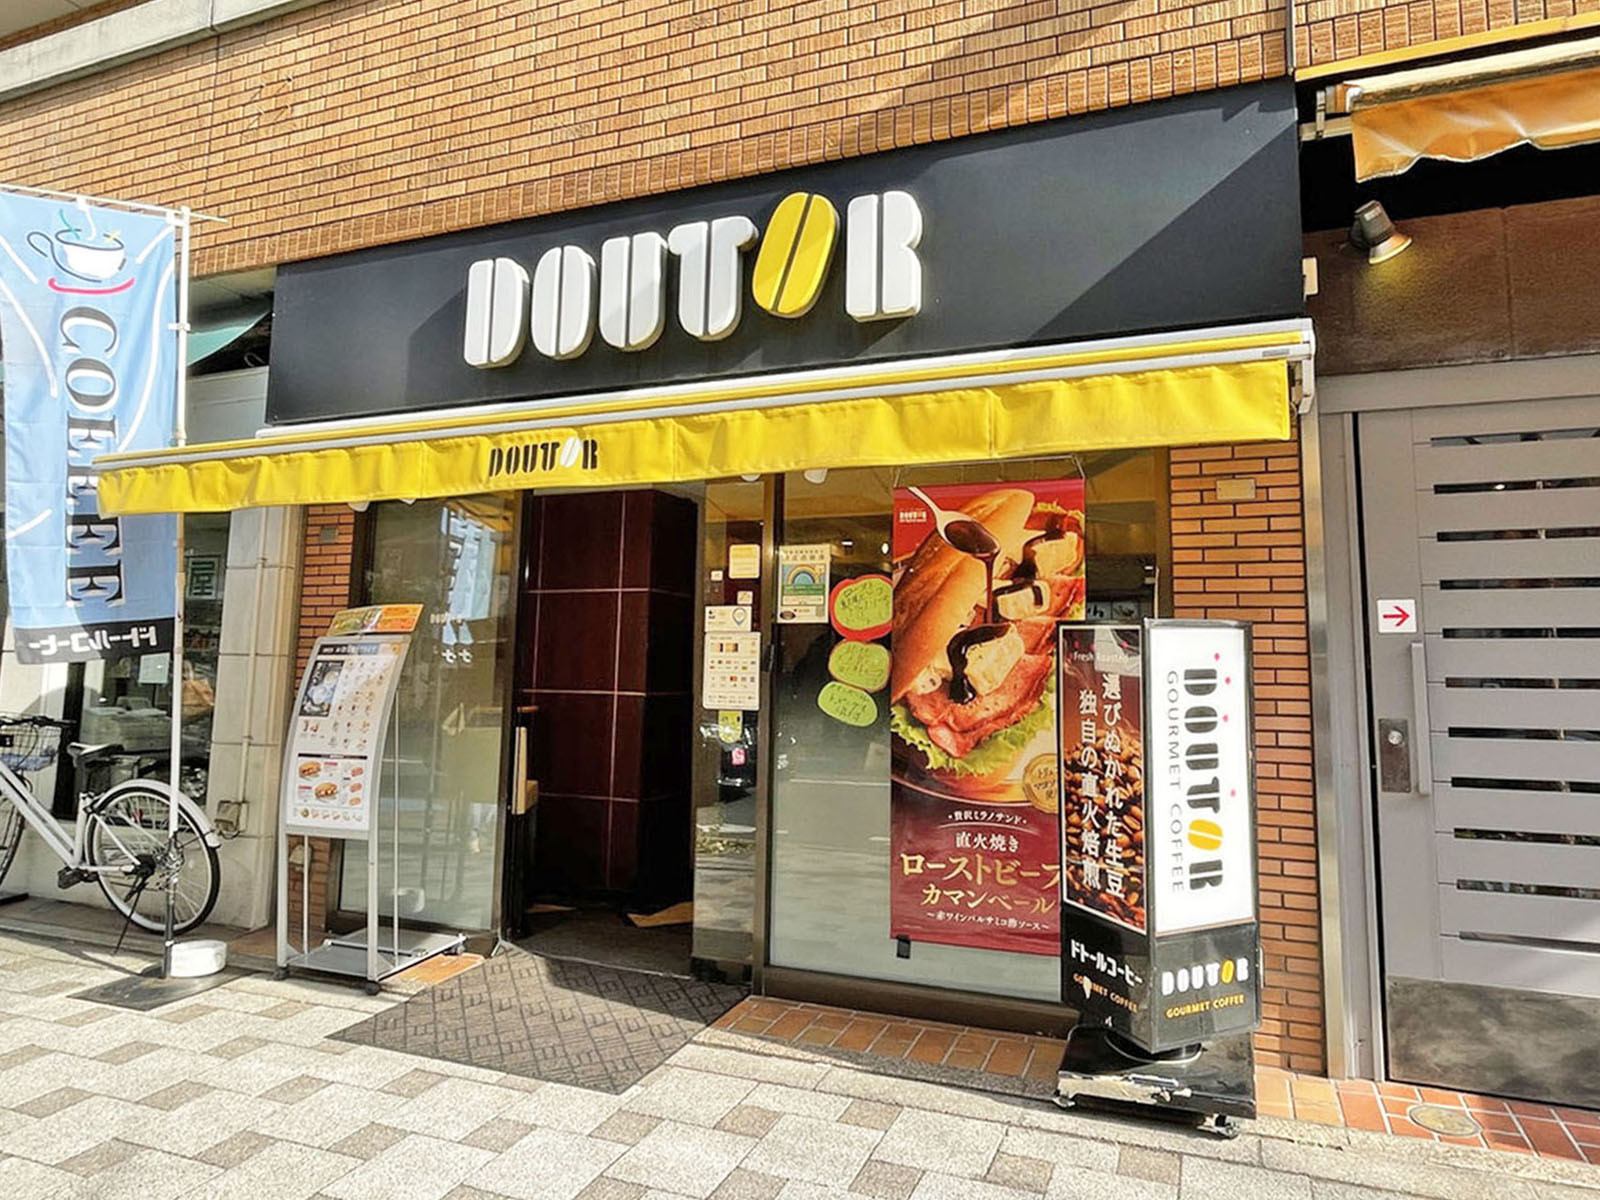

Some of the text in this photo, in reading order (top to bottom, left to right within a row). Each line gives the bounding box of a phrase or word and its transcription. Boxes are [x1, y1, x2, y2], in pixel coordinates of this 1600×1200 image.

[463, 190, 923, 369] DOUTOR
[489, 437, 598, 477] DOUTOR
[1079, 688, 1101, 890] 独自の直火焙煎
[1102, 673, 1125, 899] 選びぬかれた生豆
[1166, 670, 1185, 892] GOURMET COFFEE
[1184, 668, 1223, 890] DOUTOR
[955, 831, 1019, 852] 直火焼き
[900, 853, 1060, 890] ローストビーフ
[920, 883, 1056, 915] カマンベール
[1071, 939, 1143, 987] ドトールコーヒー
[1161, 957, 1249, 996] DOUTOR
[1109, 991, 1138, 1013] COFFEE
[1165, 994, 1245, 1018] GOURMET COFFEE
